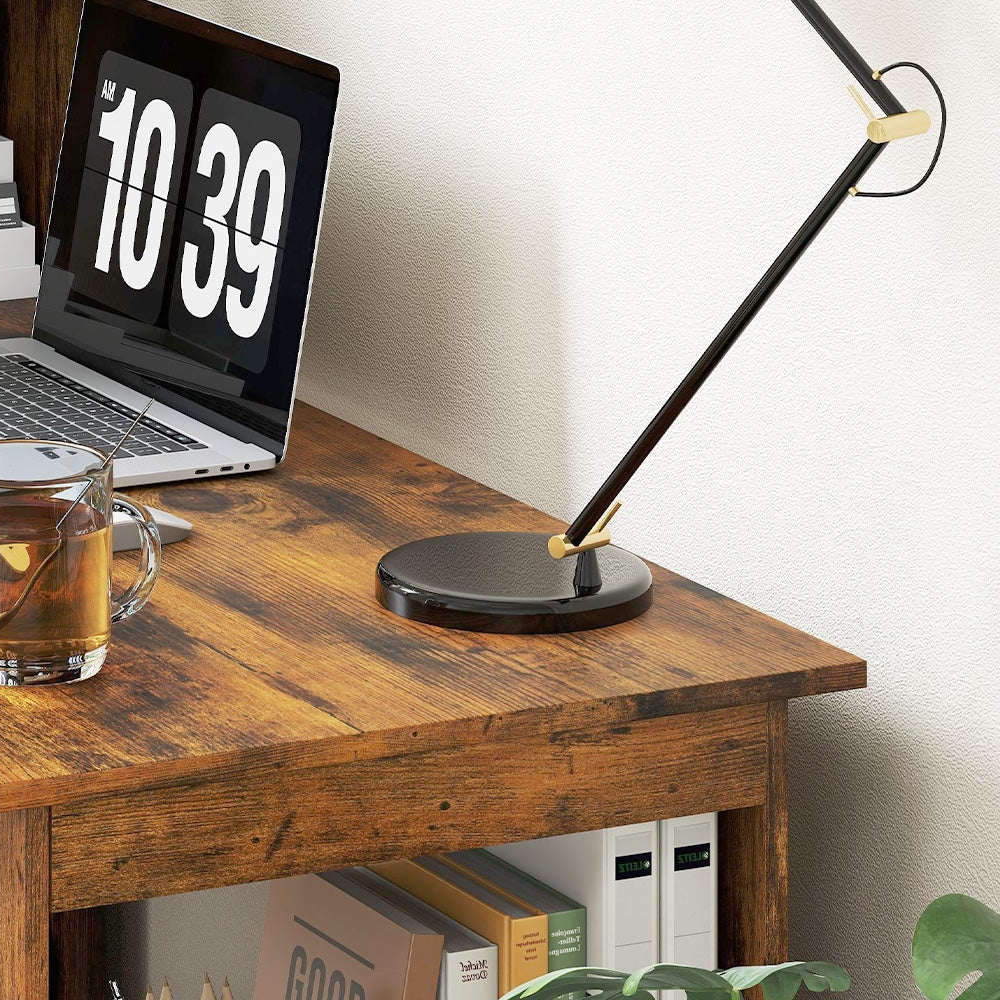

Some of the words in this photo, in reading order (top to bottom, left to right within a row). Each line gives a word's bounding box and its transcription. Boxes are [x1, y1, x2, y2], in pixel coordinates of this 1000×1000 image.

[101, 81, 115, 102] AM
[94, 87, 177, 291] 10
[179, 122, 286, 339] 39
[285, 945, 366, 1000] GO
